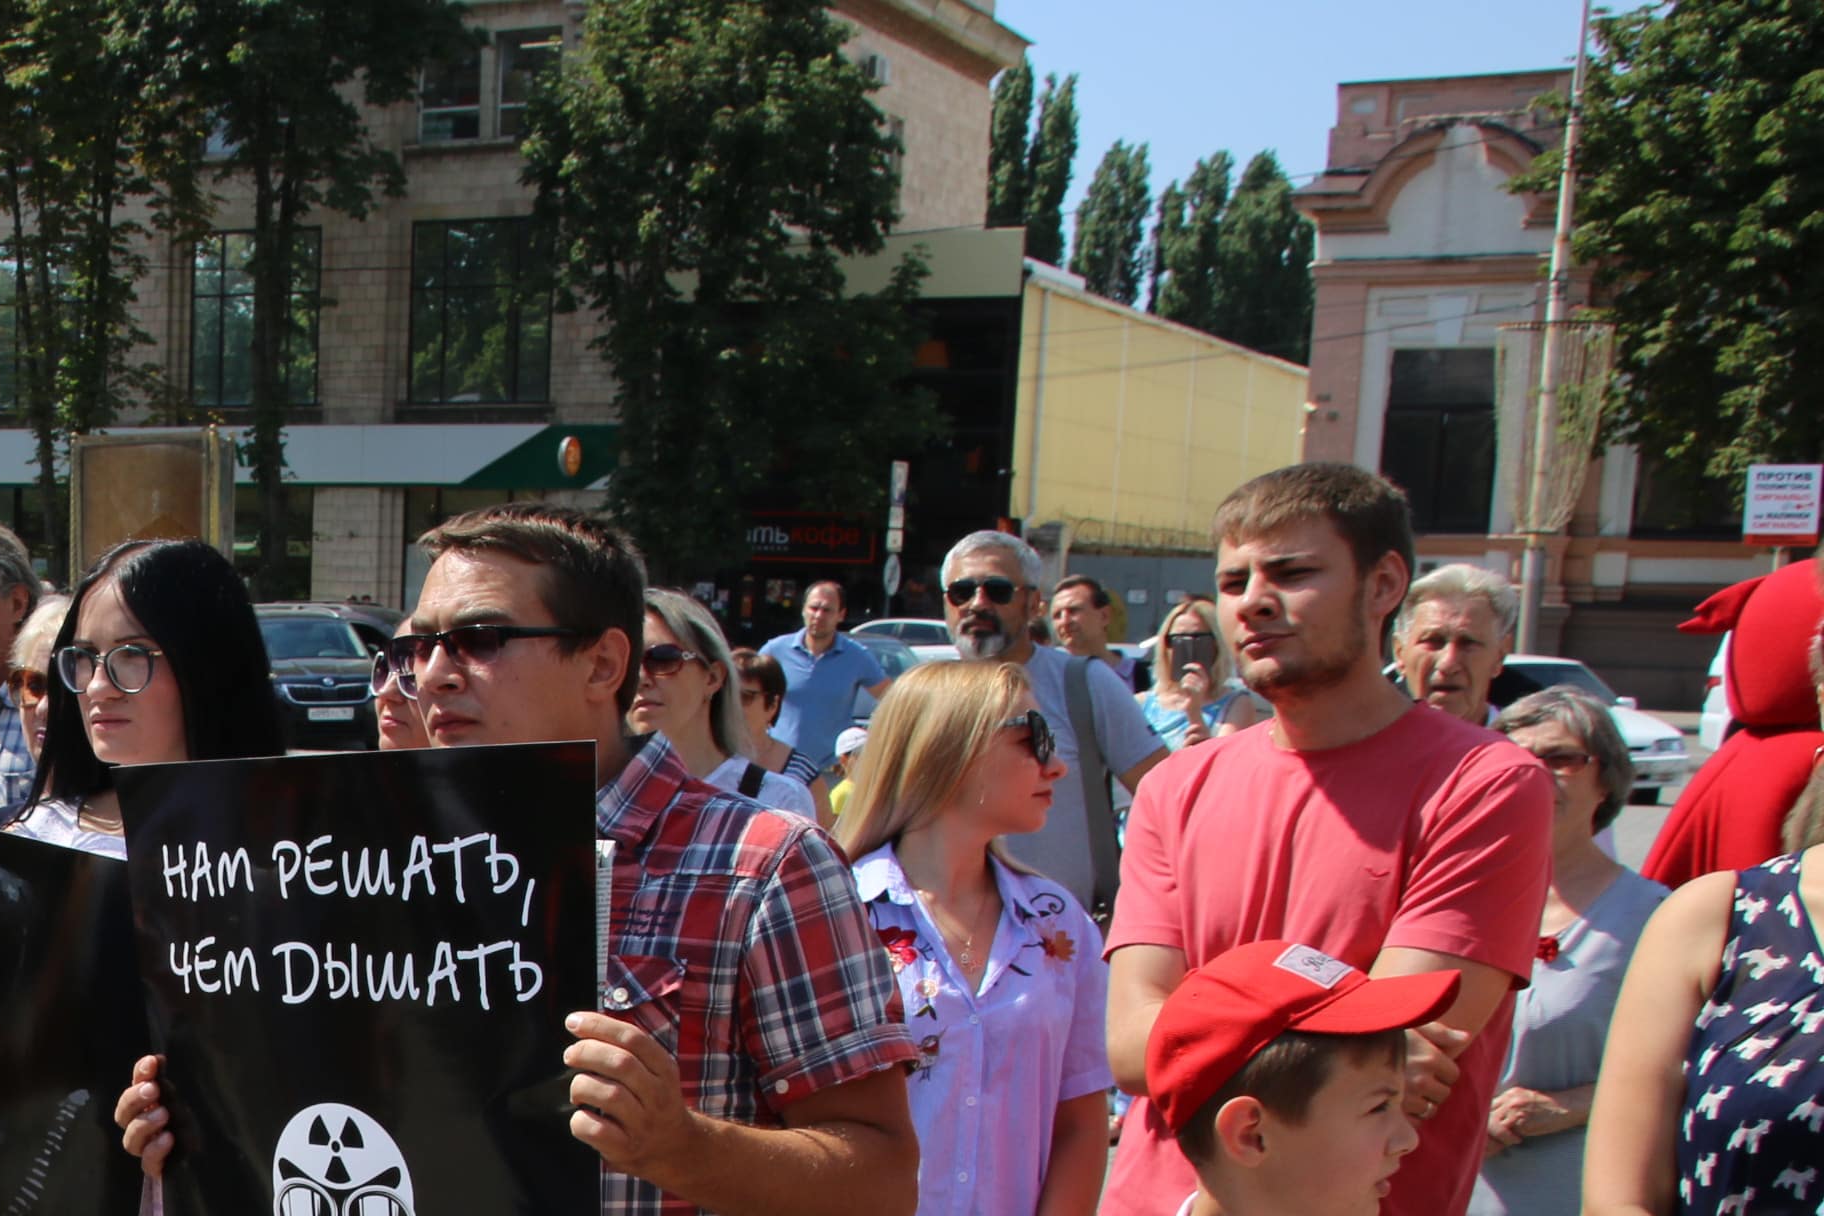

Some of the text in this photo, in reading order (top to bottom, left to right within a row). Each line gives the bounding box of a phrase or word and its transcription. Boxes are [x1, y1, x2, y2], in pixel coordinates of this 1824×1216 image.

[162, 841, 254, 902] НАМ
[272, 832, 535, 927] РЕШАТЬ,
[169, 936, 260, 995] ЧЕМ
